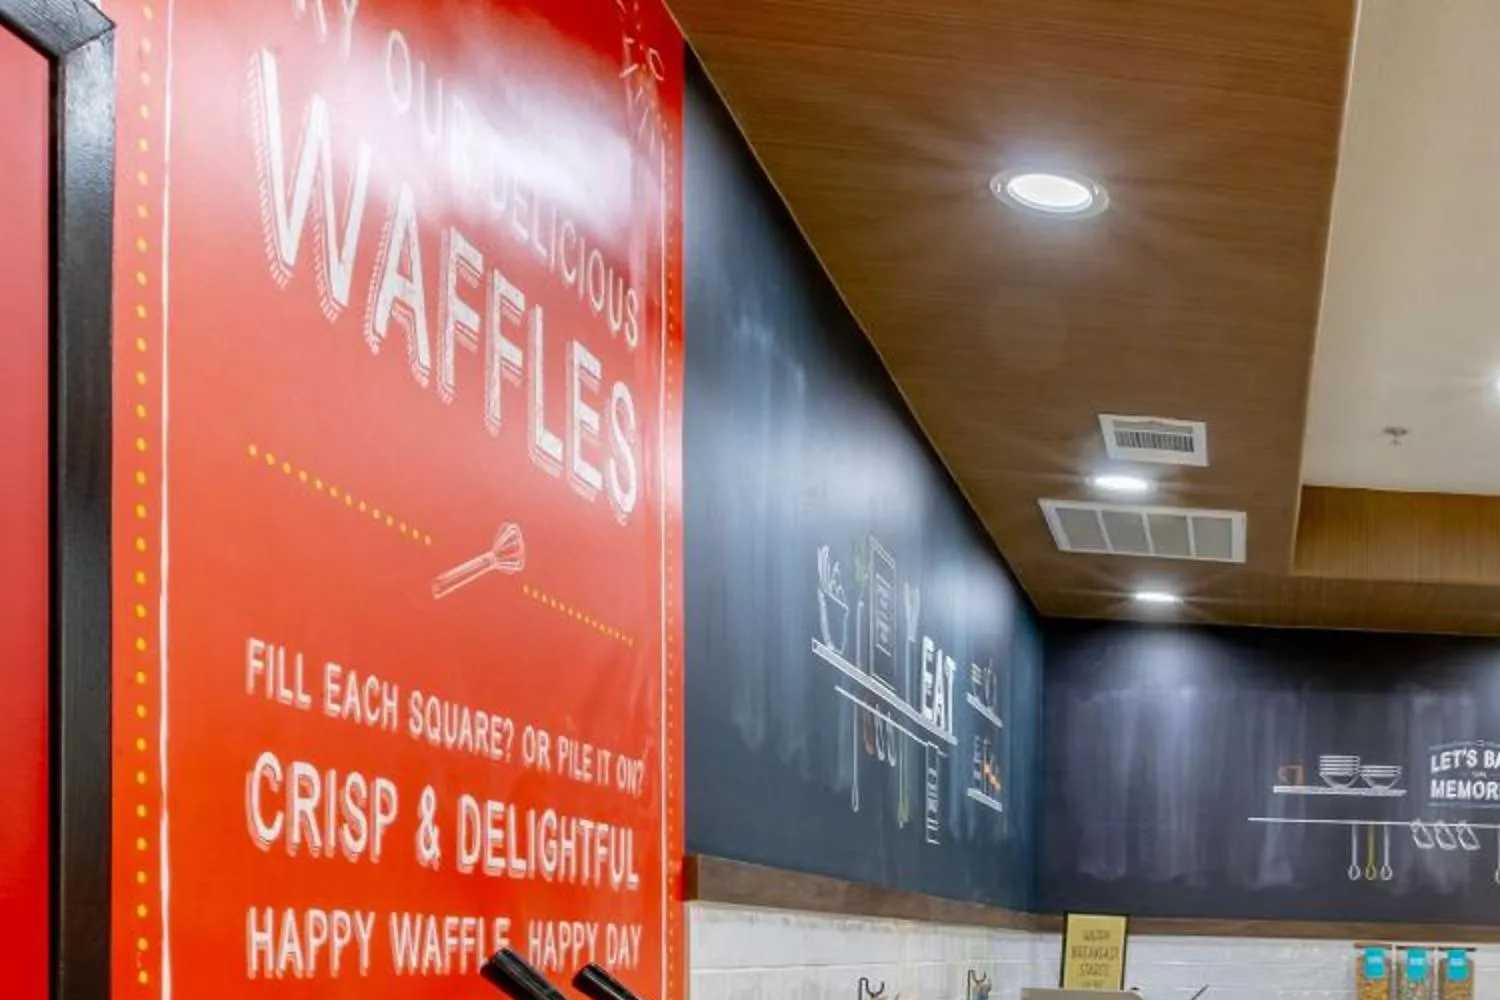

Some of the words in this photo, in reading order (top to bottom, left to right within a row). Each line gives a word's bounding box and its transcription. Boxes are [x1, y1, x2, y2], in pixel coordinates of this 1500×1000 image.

[248, 46, 640, 526] WAFFLES
[246, 637, 312, 711] FILL
[323, 662, 399, 731] EACH
[408, 690, 515, 760] SQUARE?
[521, 724, 551, 769] OR
[556, 734, 592, 783] PILE
[597, 746, 610, 787] IT
[615, 759, 646, 800] ON?
[921, 634, 957, 738] EAT
[246, 751, 399, 865] CRISP
[416, 785, 441, 871] &
[456, 794, 641, 891] DELIGHTFUL
[1431, 748, 1478, 774] LET'S
[245, 906, 376, 980] HAPPY
[526, 918, 600, 974] HAPPY
[605, 922, 643, 971] DAY
